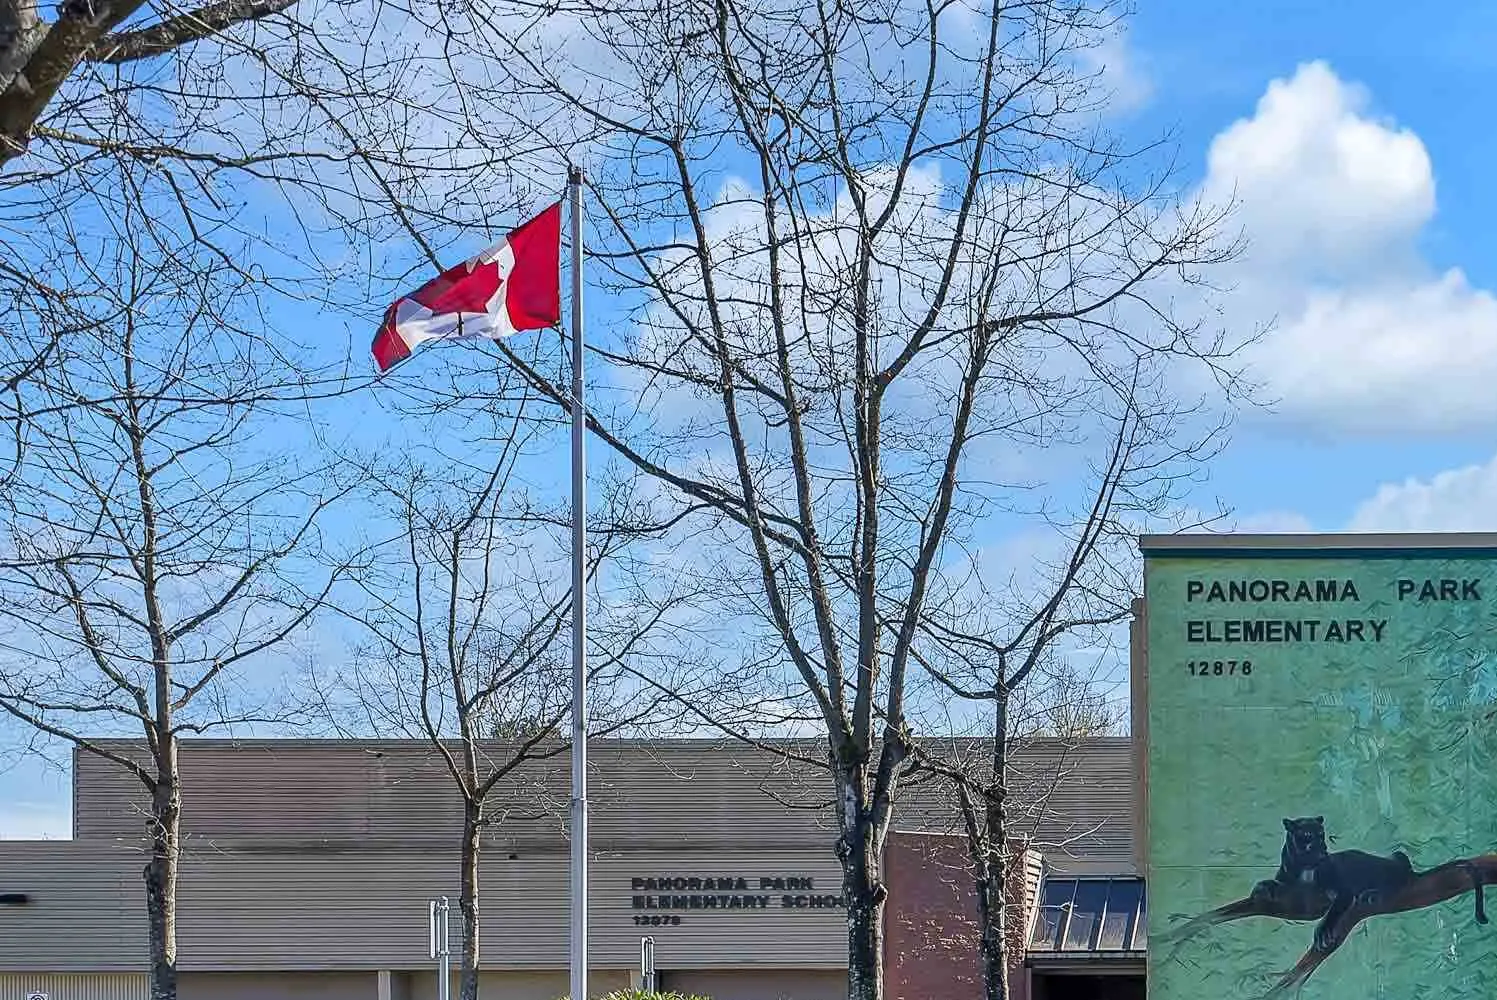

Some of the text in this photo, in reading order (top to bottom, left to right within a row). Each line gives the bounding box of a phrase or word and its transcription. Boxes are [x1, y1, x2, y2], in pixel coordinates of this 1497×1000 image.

[1187, 578, 1482, 602] PANORAMA PARK
[1187, 620, 1388, 642] ELEMENTARY
[1187, 661, 1252, 676] 12878
[632, 877, 813, 891] PANORAMA PARK
[632, 895, 848, 909] ELEMENTARY SCHOO
